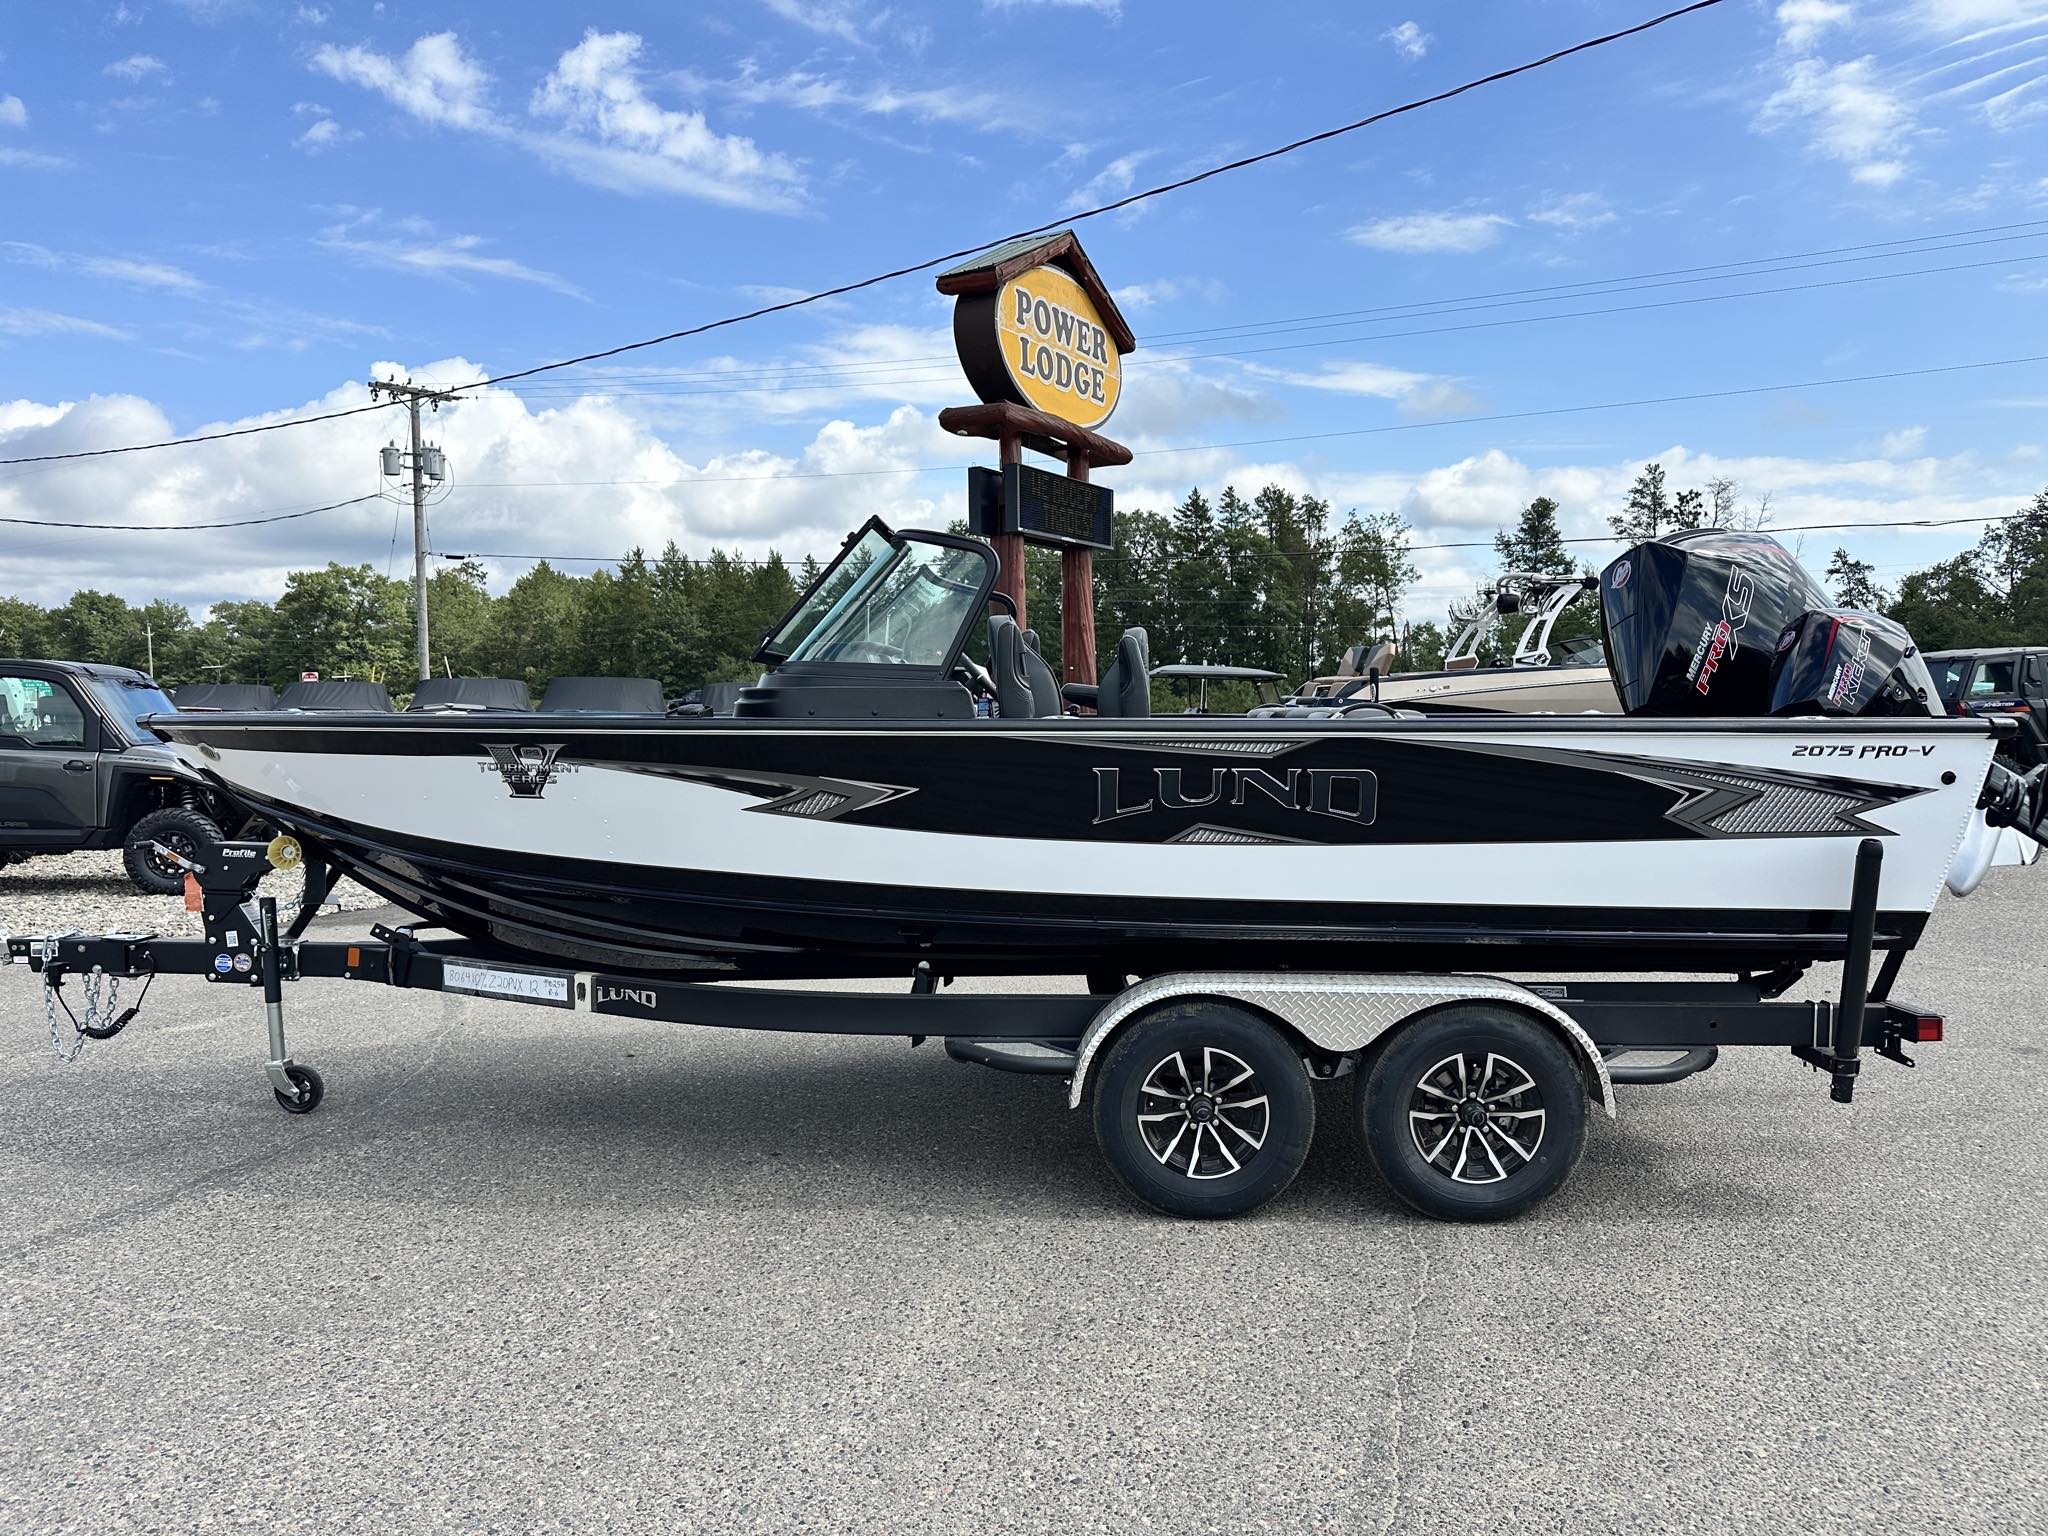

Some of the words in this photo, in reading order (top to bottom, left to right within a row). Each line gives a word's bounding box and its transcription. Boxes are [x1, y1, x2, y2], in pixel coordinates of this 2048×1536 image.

[1015, 287, 1108, 365] POWER
[1019, 335, 1106, 404] LODGE
[1696, 619, 1732, 696] PRO
[1721, 564, 1755, 661] XS
[1685, 621, 1714, 682] MERCURY
[1827, 664, 1843, 701] MERCURY
[1832, 662, 1853, 707] PRO
[476, 761, 581, 774] TOURNAMENT
[1791, 744, 1856, 757] 2075
[1858, 744, 1937, 760] PRO-V
[501, 774, 558, 785] SERIES
[1091, 767, 1379, 826] LUND
[222, 848, 257, 857] Profile
[596, 986, 657, 1009] LUND
